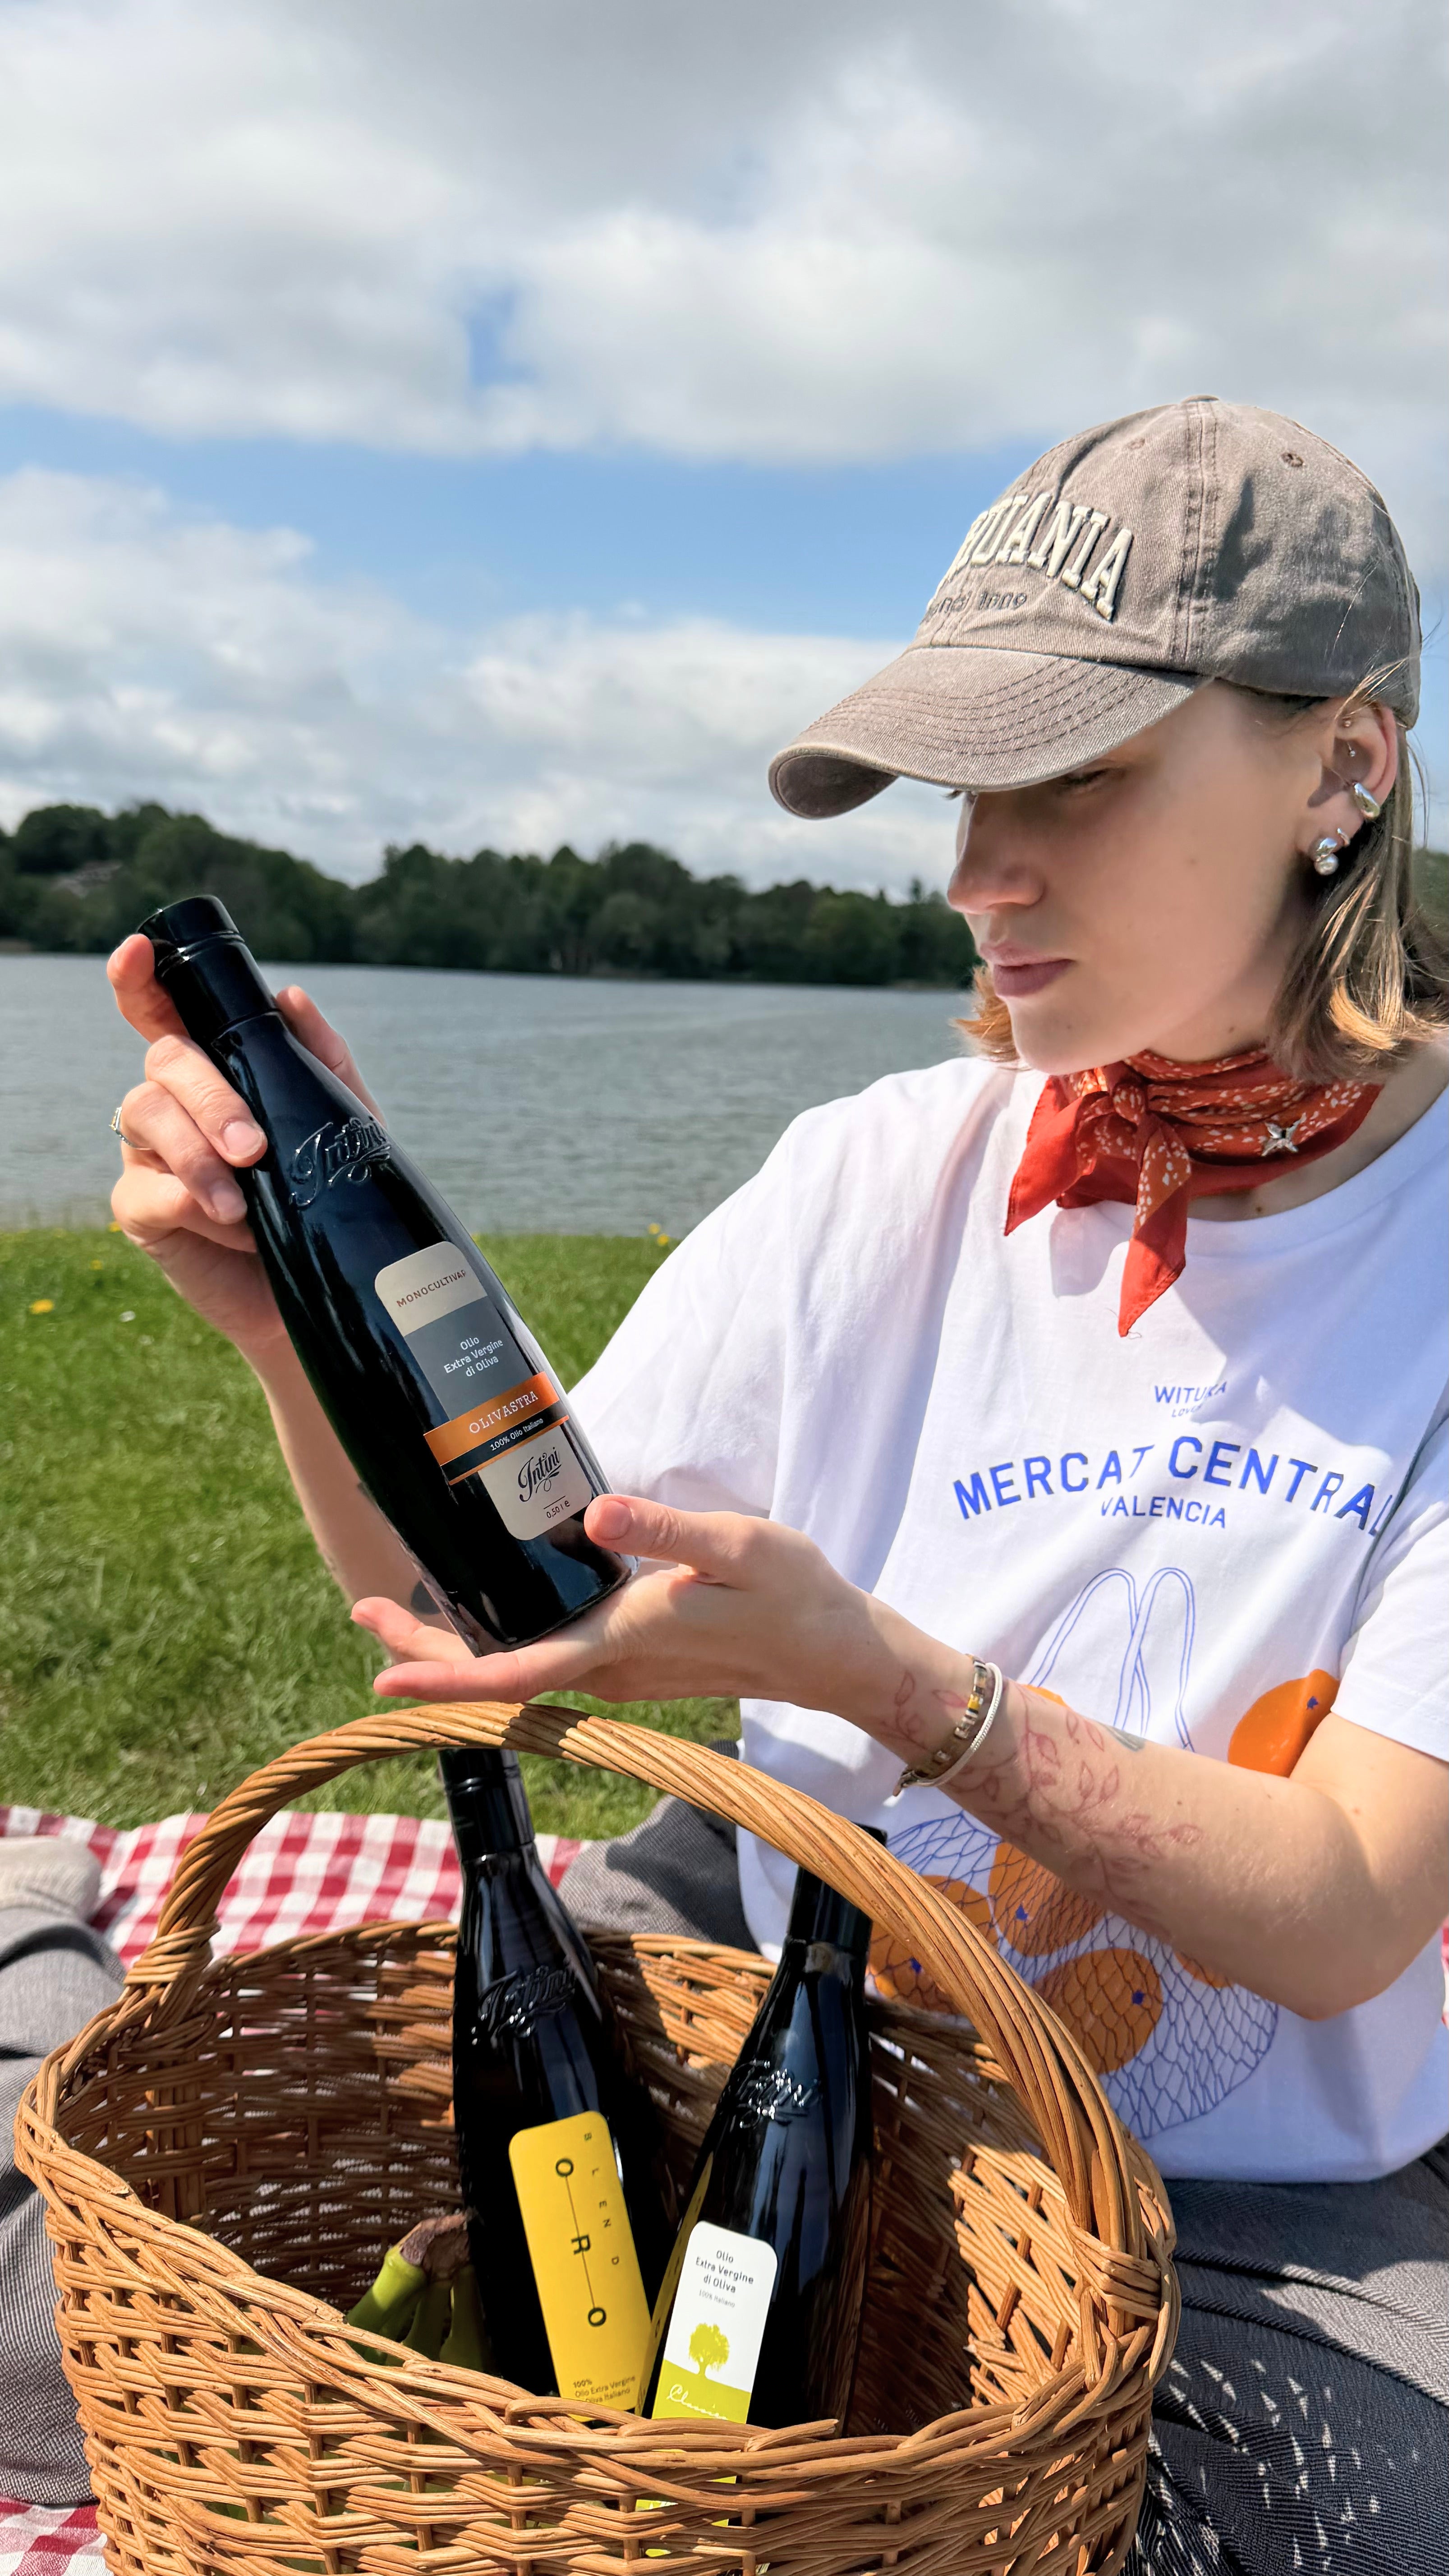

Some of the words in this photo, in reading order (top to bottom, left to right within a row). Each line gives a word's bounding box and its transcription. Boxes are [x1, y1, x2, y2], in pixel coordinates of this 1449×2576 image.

[443, 1355, 472, 1374] Extra
[470, 1339, 504, 1359] Vergine
[460, 1336, 480, 1351] Olio
[465, 1365, 476, 1377] di
[475, 1356, 499, 1372] Oliva
[469, 1391, 539, 1434] OLIVASTRA
[490, 1436, 511, 1451] 100%
[510, 1430, 523, 1440] Olio
[522, 1418, 544, 1433] Italiano
[518, 1446, 562, 1502] Intini
[953, 1444, 1155, 1520] MERCAT
[1101, 1495, 1227, 1529] VALENCIA
[695, 2256, 716, 2272] Extra
[718, 2264, 754, 2285] Vergine
[716, 2249, 734, 2263] Olio
[703, 2273, 712, 2285] di
[713, 2277, 736, 2294] Oliva
[573, 2378, 593, 2389] 100%
[590, 2385, 609, 2395] Extra
